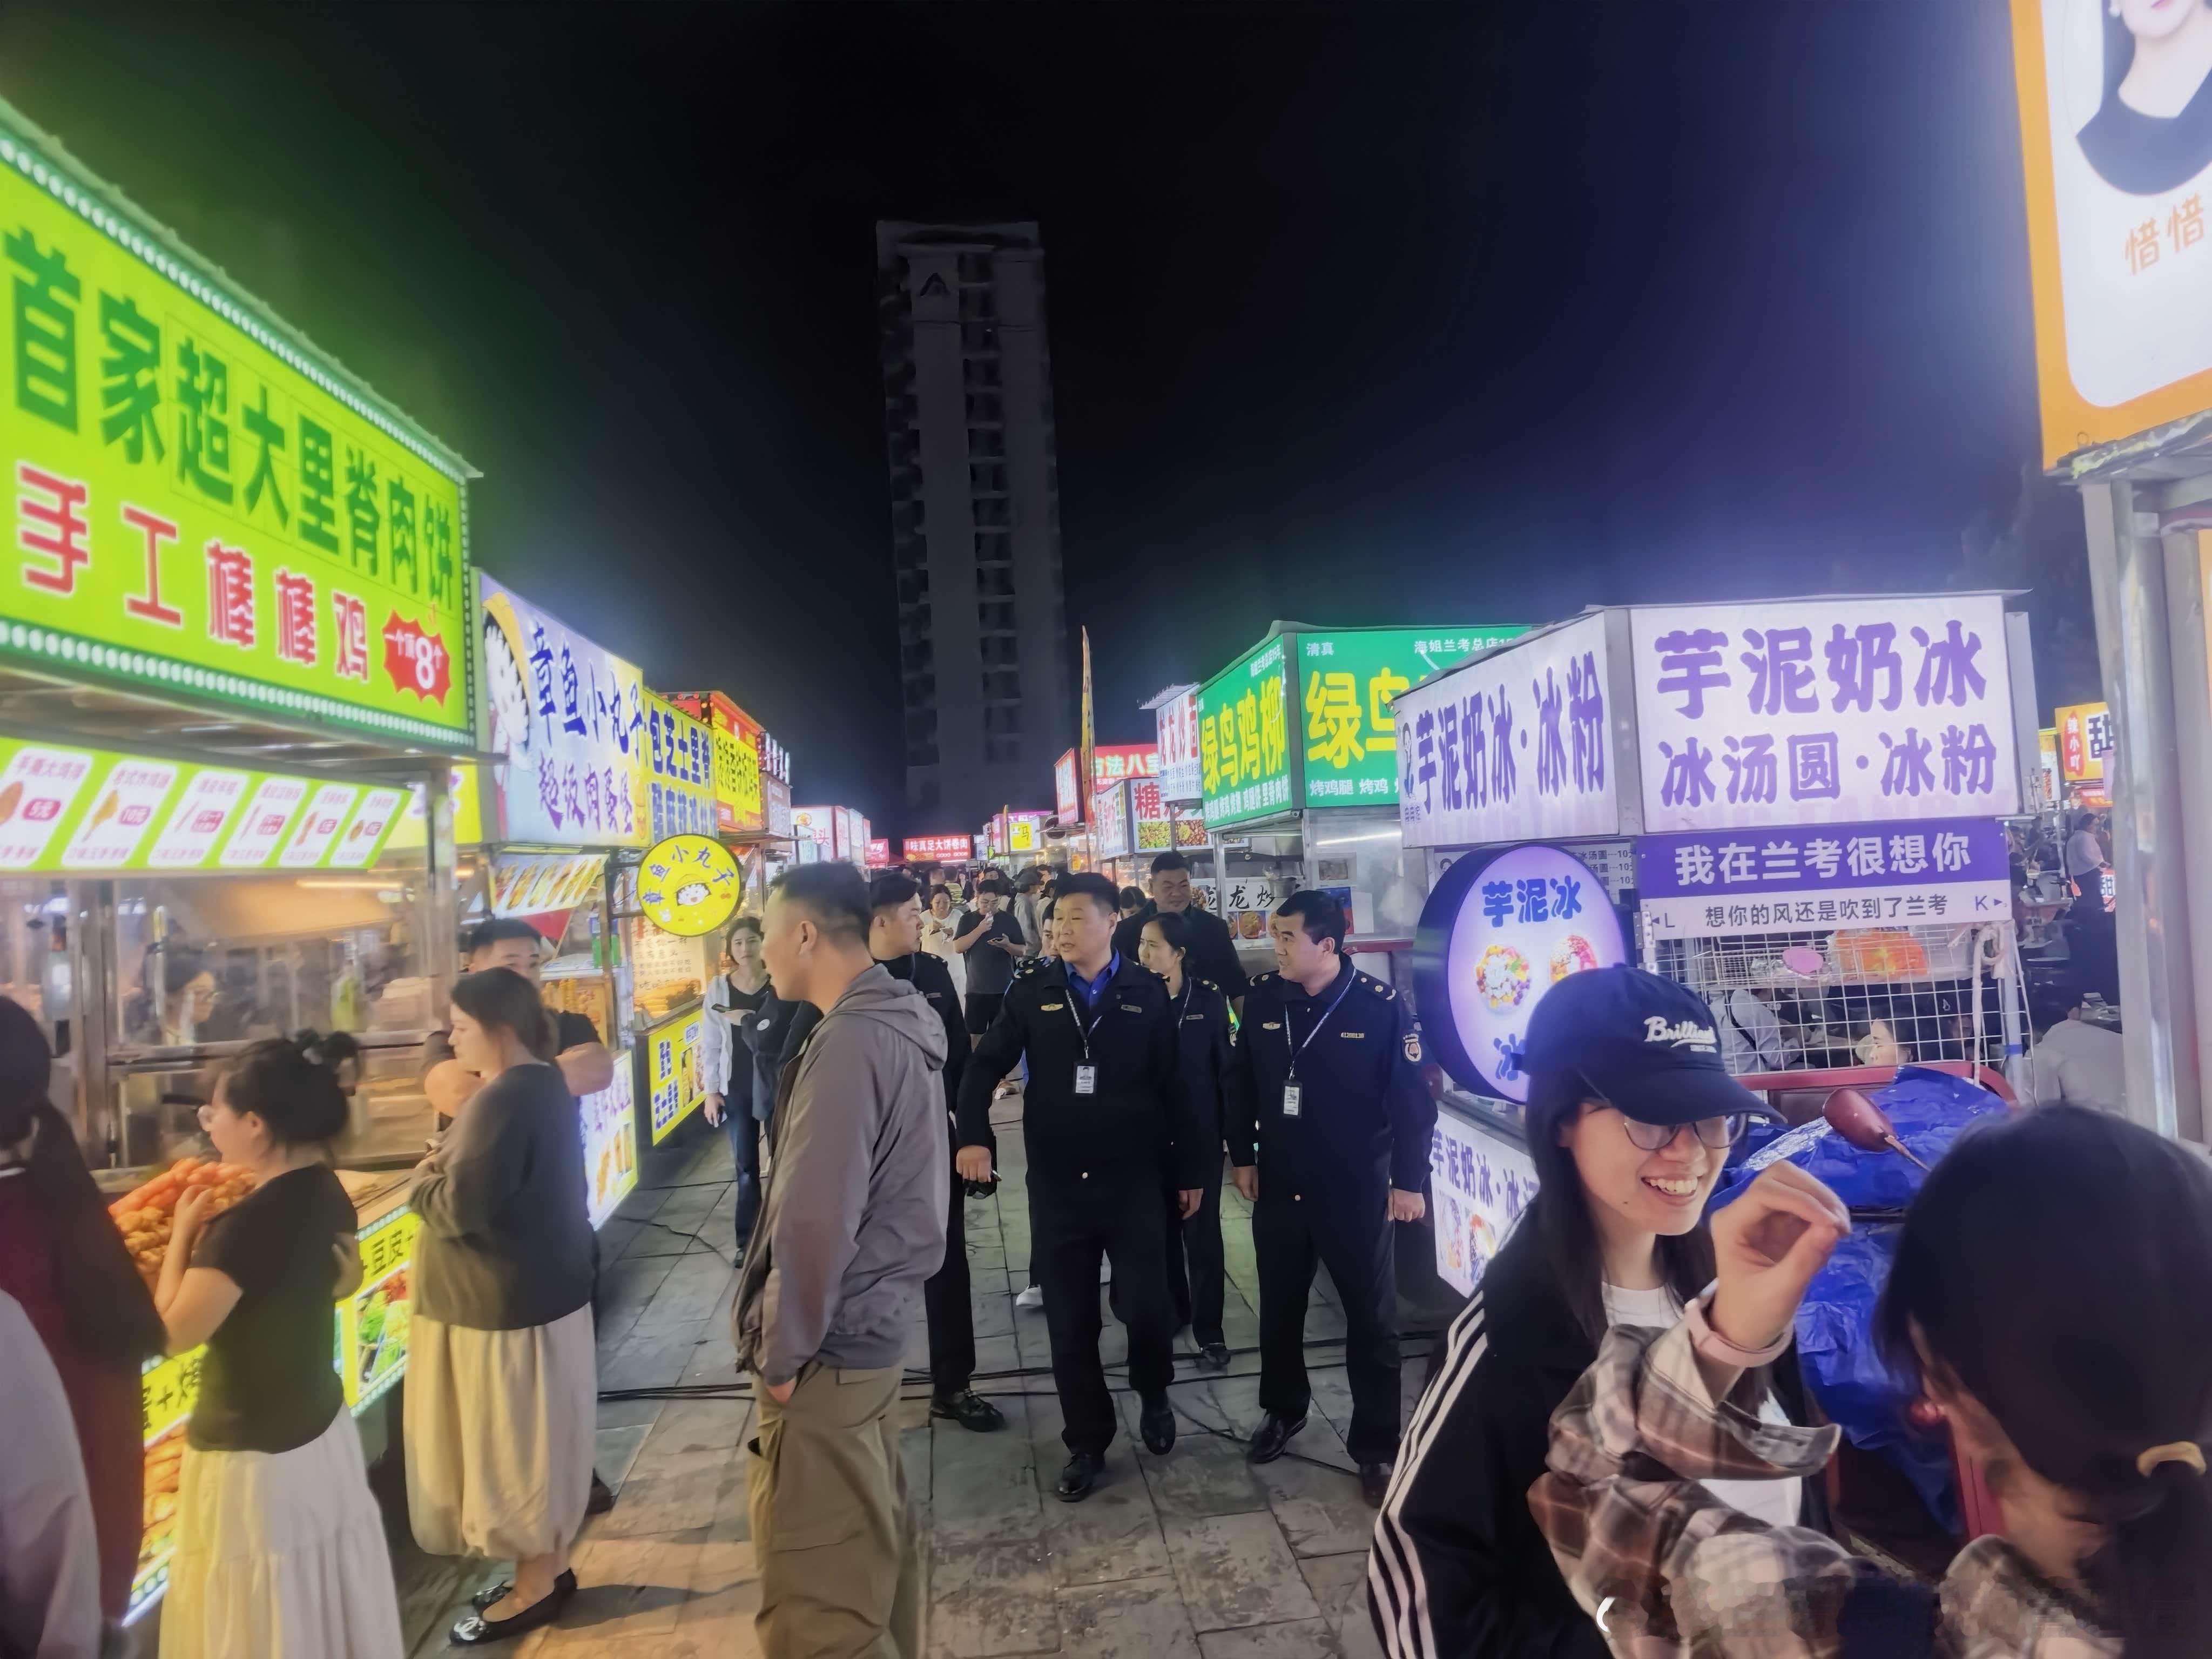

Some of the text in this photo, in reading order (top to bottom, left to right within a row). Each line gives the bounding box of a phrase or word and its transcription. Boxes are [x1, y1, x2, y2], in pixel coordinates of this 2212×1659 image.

[2, 225, 454, 611] 首家超大里脊肉饼
[1306, 642, 1334, 656] 清真
[1654, 619, 1987, 719] 芋泥奶冰
[529, 624, 643, 763] 章鱼小丸子
[1201, 675, 1286, 794] 绿鸟鸡柳
[1415, 651, 1604, 815] 芋泥奶冰·冰粉
[1310, 778, 1389, 797] 烤鸡腿 烤鸡
[1658, 723, 1997, 807] 冰汤圆·冰粉
[642, 845, 736, 908] 章鱼小丸子
[1675, 832, 1972, 886] 我在兰考很想你
[1482, 875, 1582, 928] 芋泥冰
[1705, 894, 1948, 928] 想你的风还是吹到了兰考
[1974, 895, 1989, 912] K
